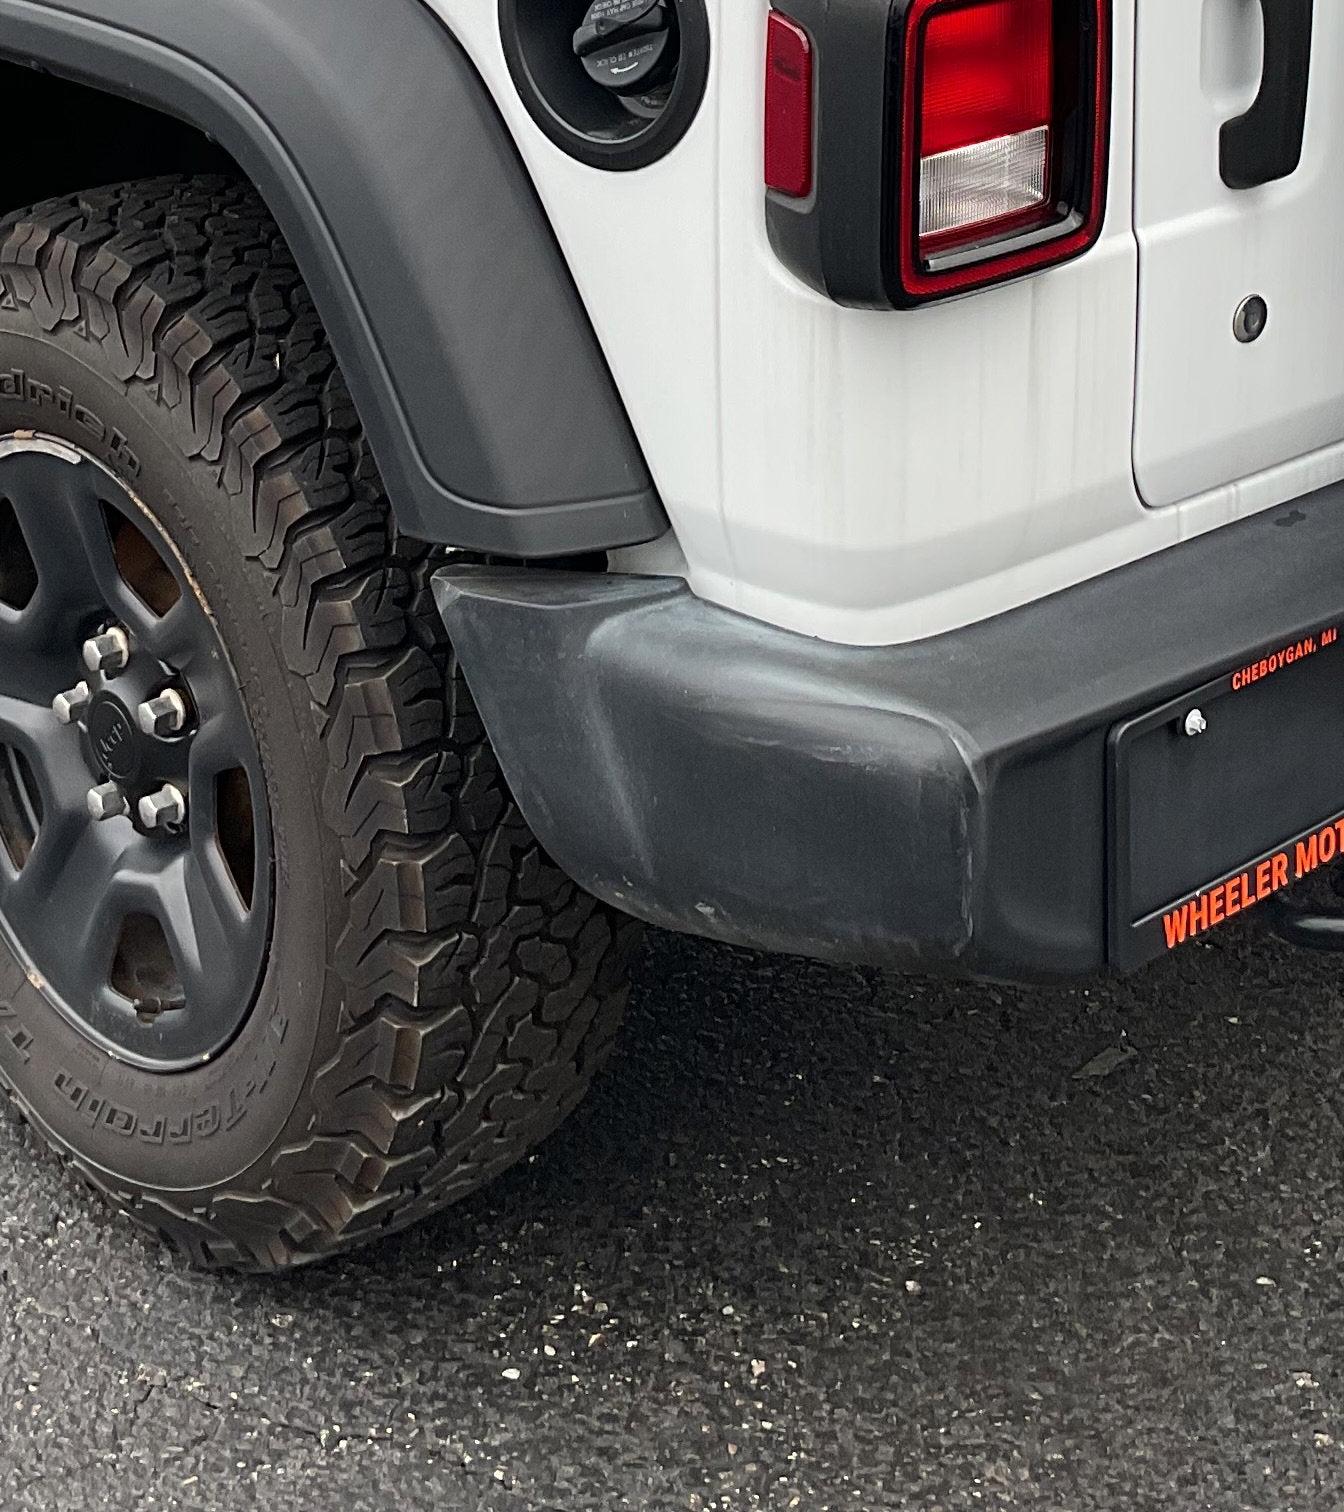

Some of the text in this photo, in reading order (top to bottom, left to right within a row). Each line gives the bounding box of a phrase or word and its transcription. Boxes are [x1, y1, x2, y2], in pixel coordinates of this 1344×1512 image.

[1232, 627, 1337, 690] CHEBOYGAN, MI
[1163, 852, 1289, 949] WHEELER
